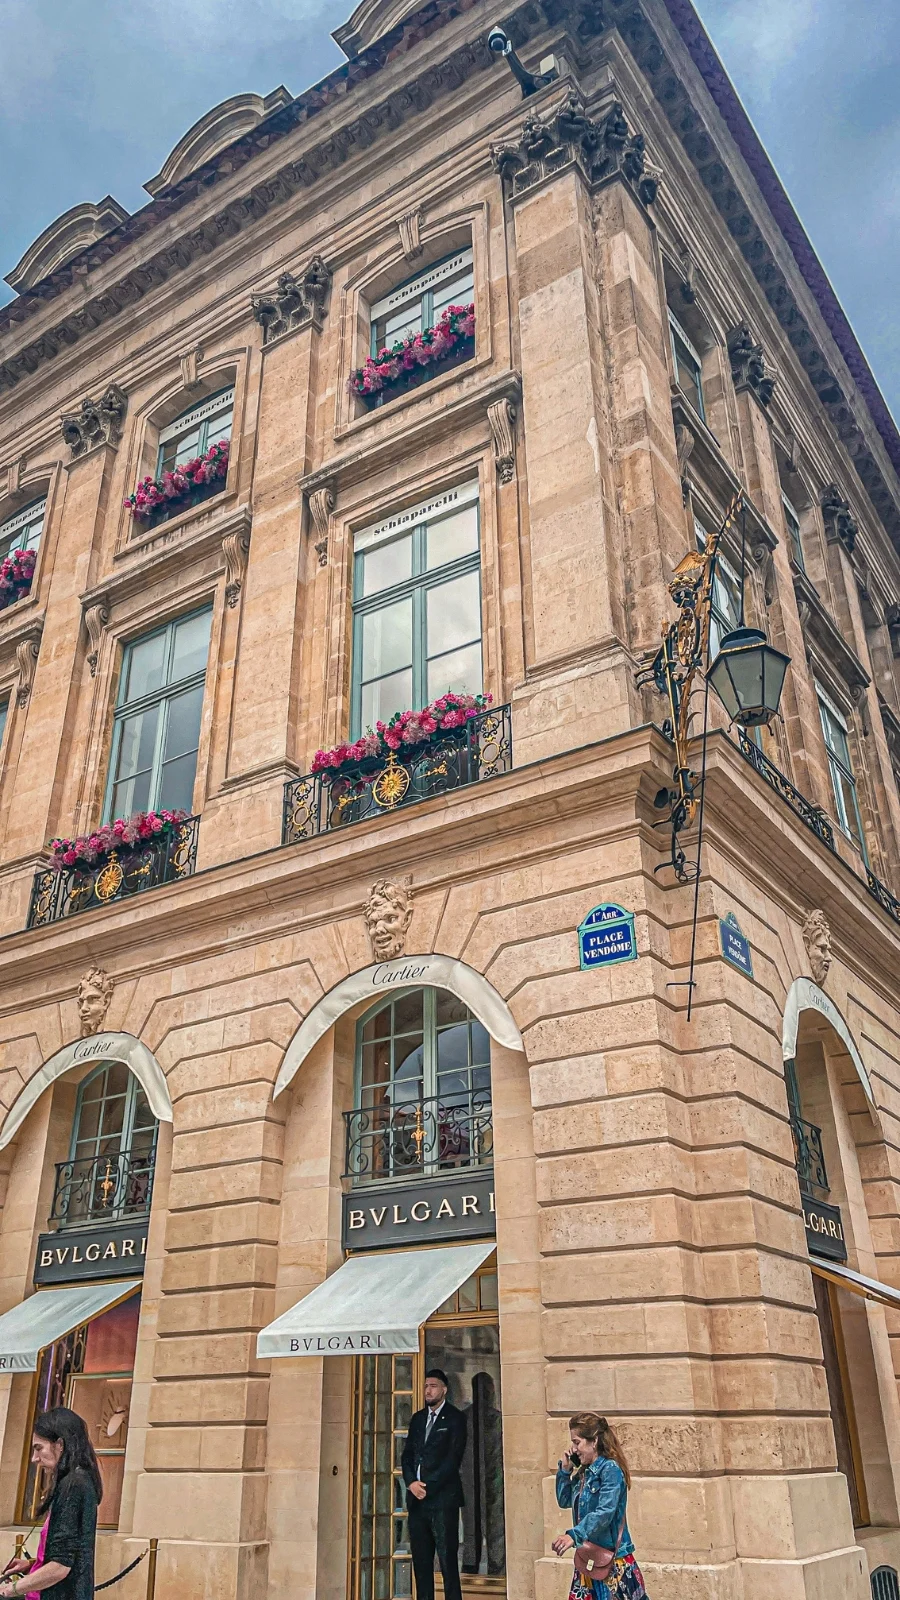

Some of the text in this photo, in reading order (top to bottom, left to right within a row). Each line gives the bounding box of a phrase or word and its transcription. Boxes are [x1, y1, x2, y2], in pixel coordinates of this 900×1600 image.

[374, 491, 458, 536] schiaparelli
[590, 931, 624, 946] PLACE
[584, 941, 631, 959] VENDÔME
[372, 964, 430, 986] Cartier
[73, 1041, 114, 1060] Cartier
[349, 1192, 496, 1229] BVLGARI
[40, 1237, 147, 1266] BVLGARI
[290, 1334, 382, 1352] BVLGARI
